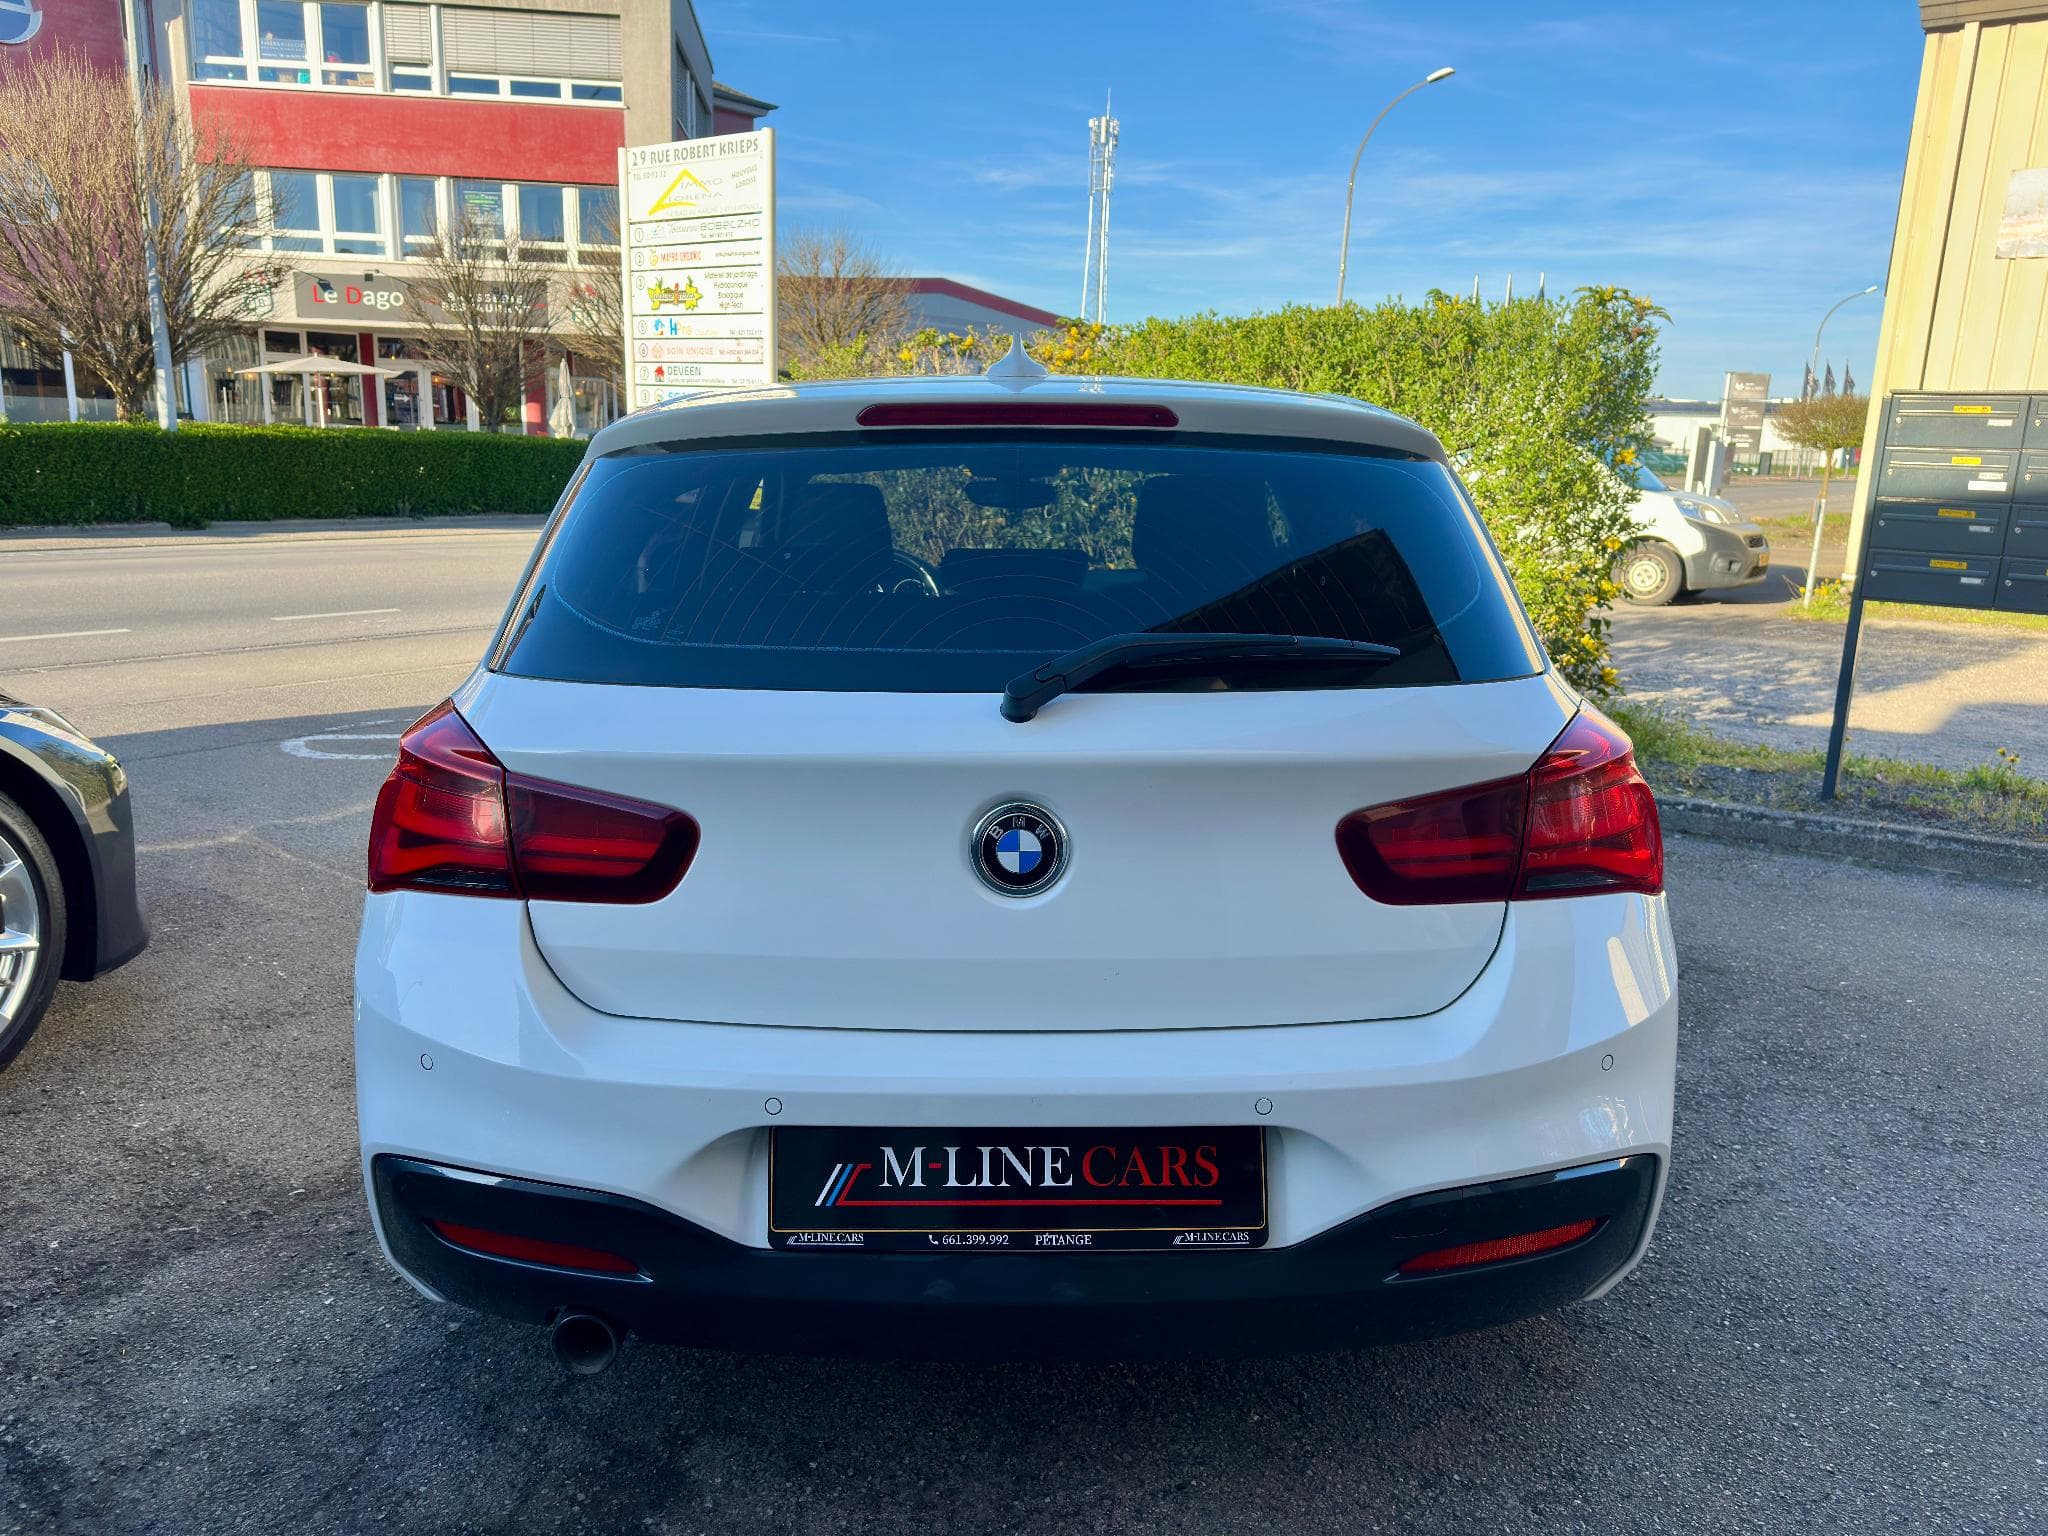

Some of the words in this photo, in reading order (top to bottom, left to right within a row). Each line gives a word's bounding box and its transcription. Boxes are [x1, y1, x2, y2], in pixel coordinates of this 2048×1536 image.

[650, 149, 670, 165] RUE
[674, 144, 717, 161] ROBERT
[719, 138, 759, 156] KRIEPS
[312, 284, 338, 304] Le
[345, 285, 405, 310] Dago
[666, 347, 685, 356] SOIN
[686, 346, 714, 357] UNIQUE
[667, 366, 702, 376] DEVEEN
[879, 1145, 1074, 1188] M-LINE
[1081, 1144, 1220, 1188] CARS
[798, 1232, 835, 1244] M-LINE
[836, 1232, 865, 1243] CARS
[942, 1234, 1010, 1246] 661.399.992
[1034, 1232, 1093, 1247] PÉTANGE
[1184, 1231, 1222, 1244] M-LINE
[1222, 1231, 1250, 1244] CARS
